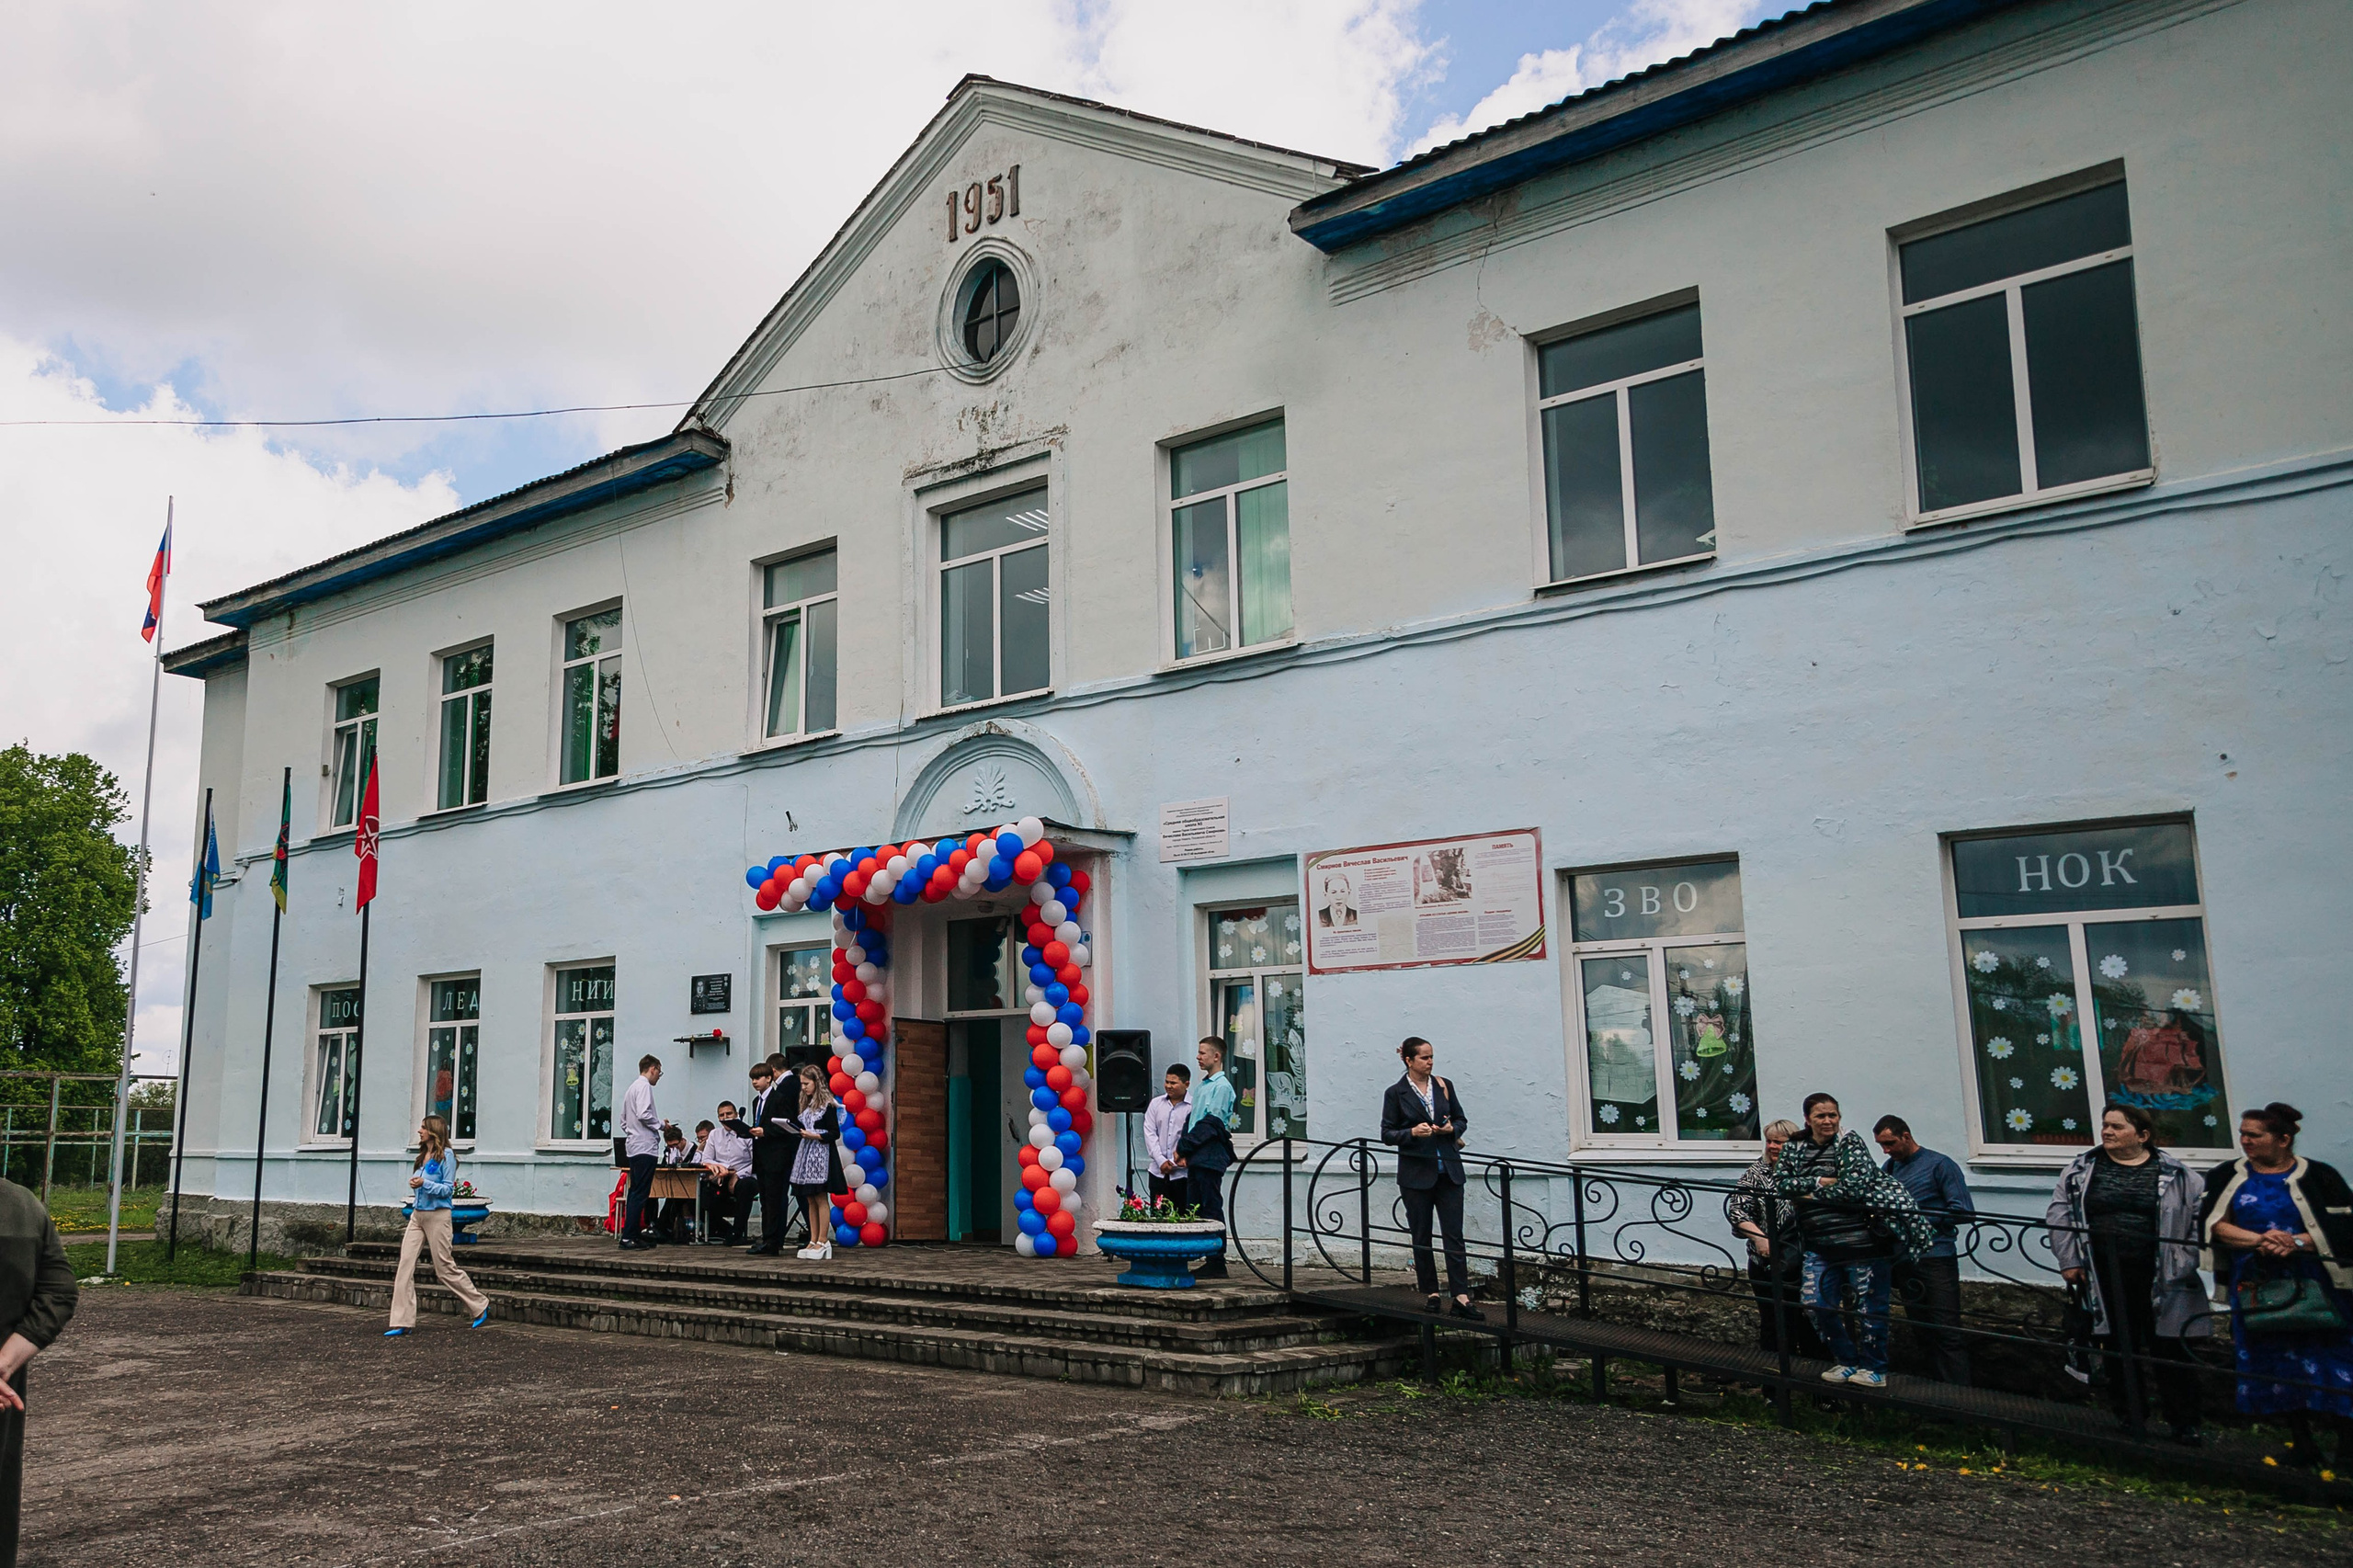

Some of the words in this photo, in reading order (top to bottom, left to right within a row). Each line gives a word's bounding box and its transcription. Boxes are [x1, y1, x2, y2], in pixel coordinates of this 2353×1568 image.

[946, 164, 1020, 243] 1951
[1316, 861, 1341, 870] Смирнов
[1343, 858, 1371, 868] Вячеслав
[1372, 855, 1408, 864] Васильевич
[2015, 848, 2138, 892] НОК
[1604, 881, 1698, 917] ЗВО
[442, 990, 479, 1011] ЛЕД
